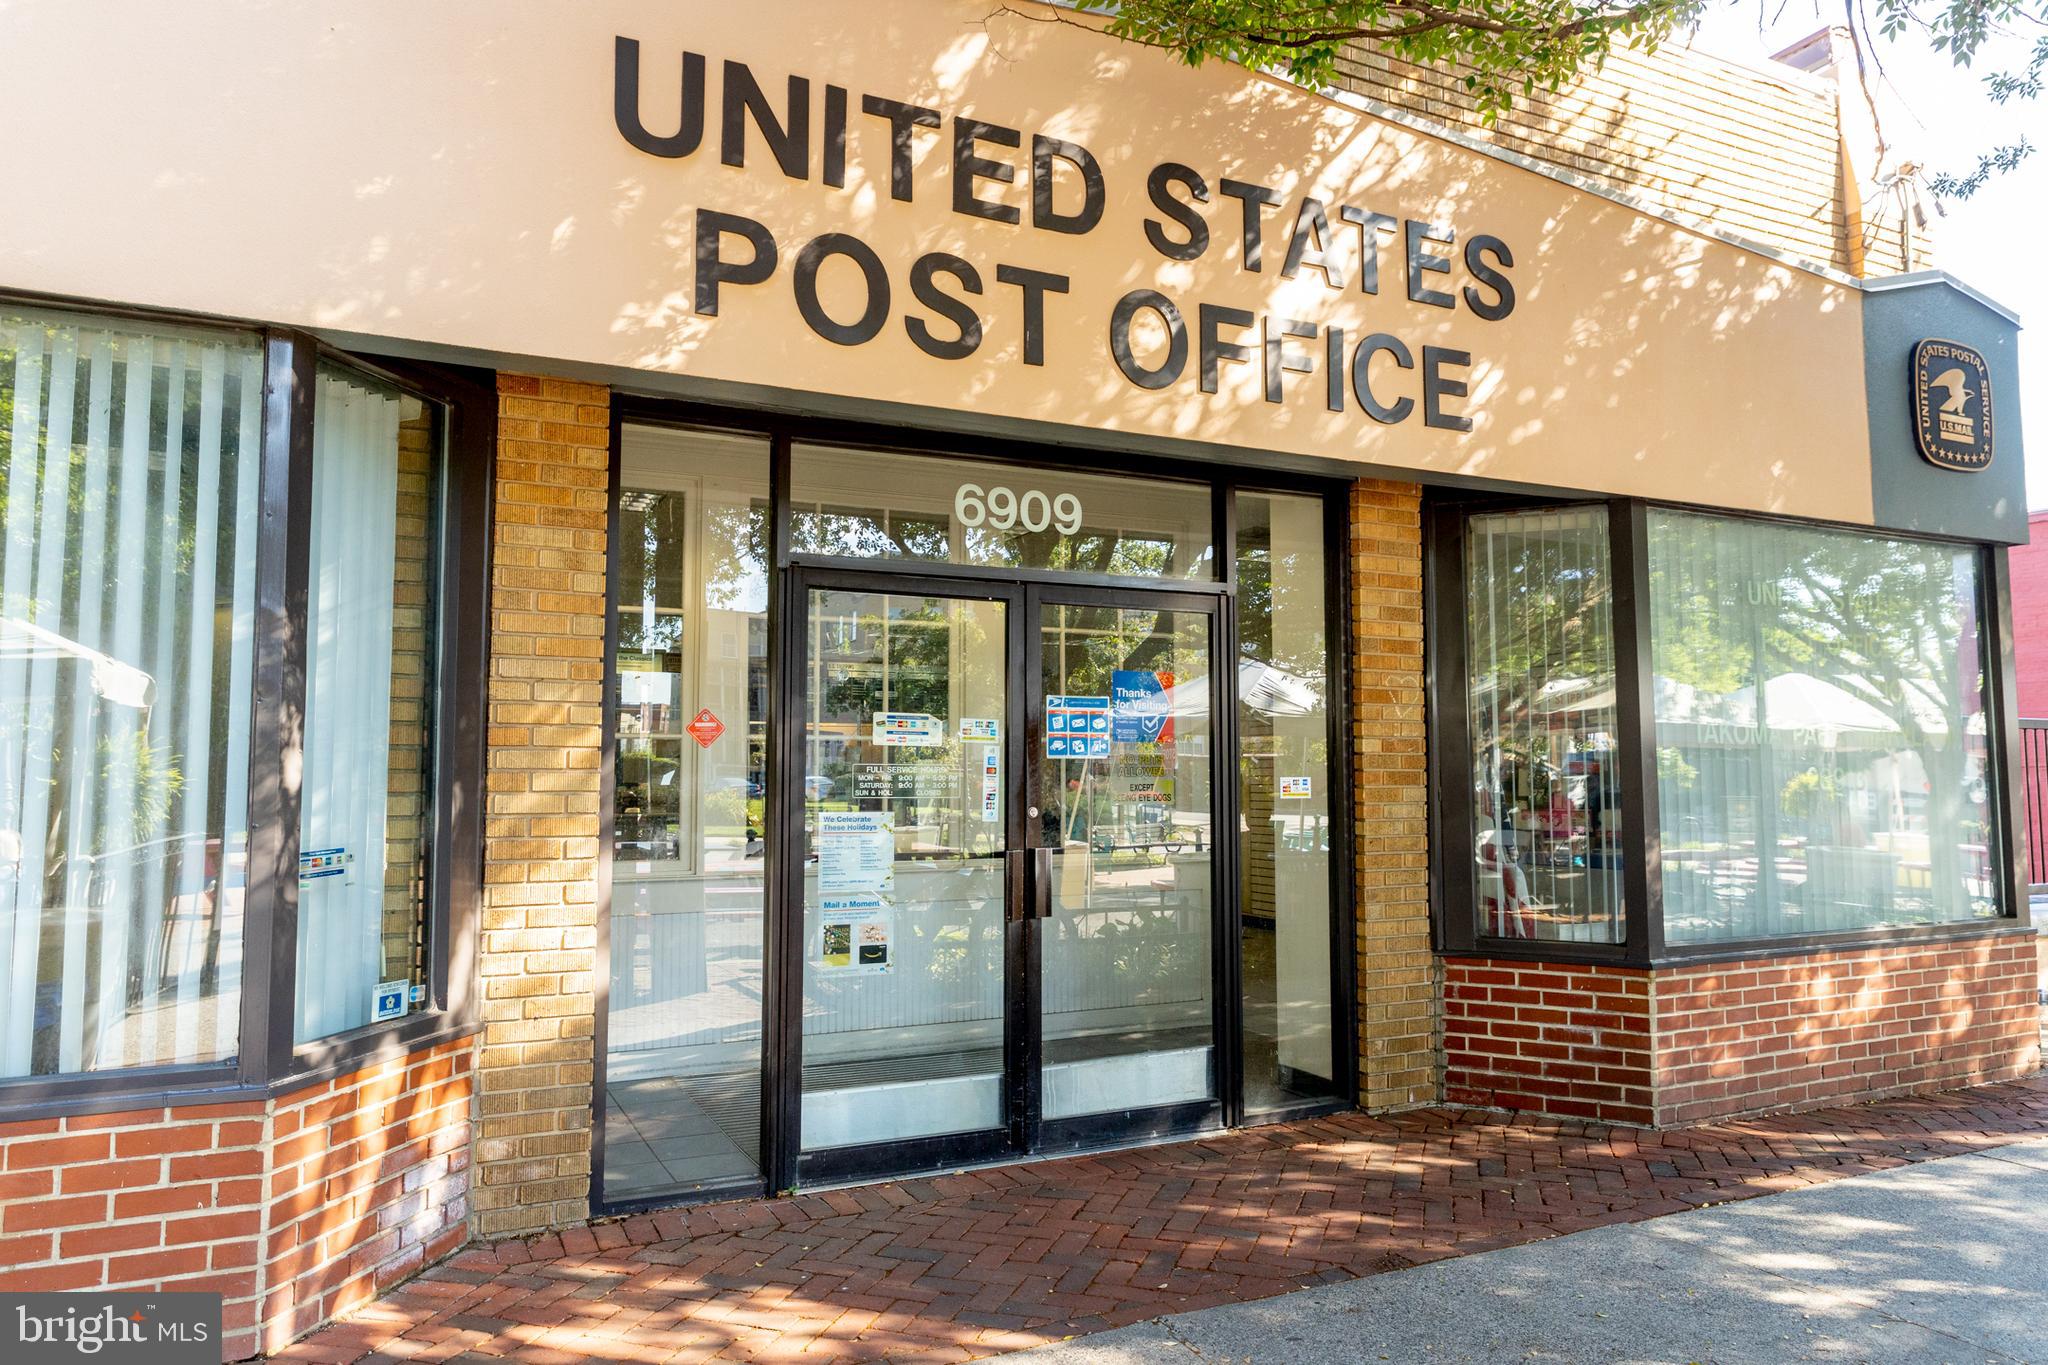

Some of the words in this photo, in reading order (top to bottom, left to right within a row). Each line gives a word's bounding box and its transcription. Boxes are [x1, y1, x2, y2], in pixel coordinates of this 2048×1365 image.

[614, 36, 1106, 235] UNITED
[1143, 162, 1516, 322] STATES
[694, 208, 1070, 367] POST
[1110, 288, 1474, 432] OFFICE
[1920, 344, 1950, 367] STATES
[1951, 348, 1985, 376] POSTAL
[1920, 371, 1931, 427] UNITED
[1980, 379, 1992, 437] SERVICE
[954, 483, 1083, 536] 6909
[1115, 700, 1130, 708] for
[1116, 688, 1152, 698] Thanks
[887, 766, 917, 774] SERVICE
[1118, 766, 1165, 778] ALLOWED
[1129, 783, 1154, 791] EXCEPT
[1138, 793, 1152, 801] EYE
[1152, 793, 1172, 801] DOGS
